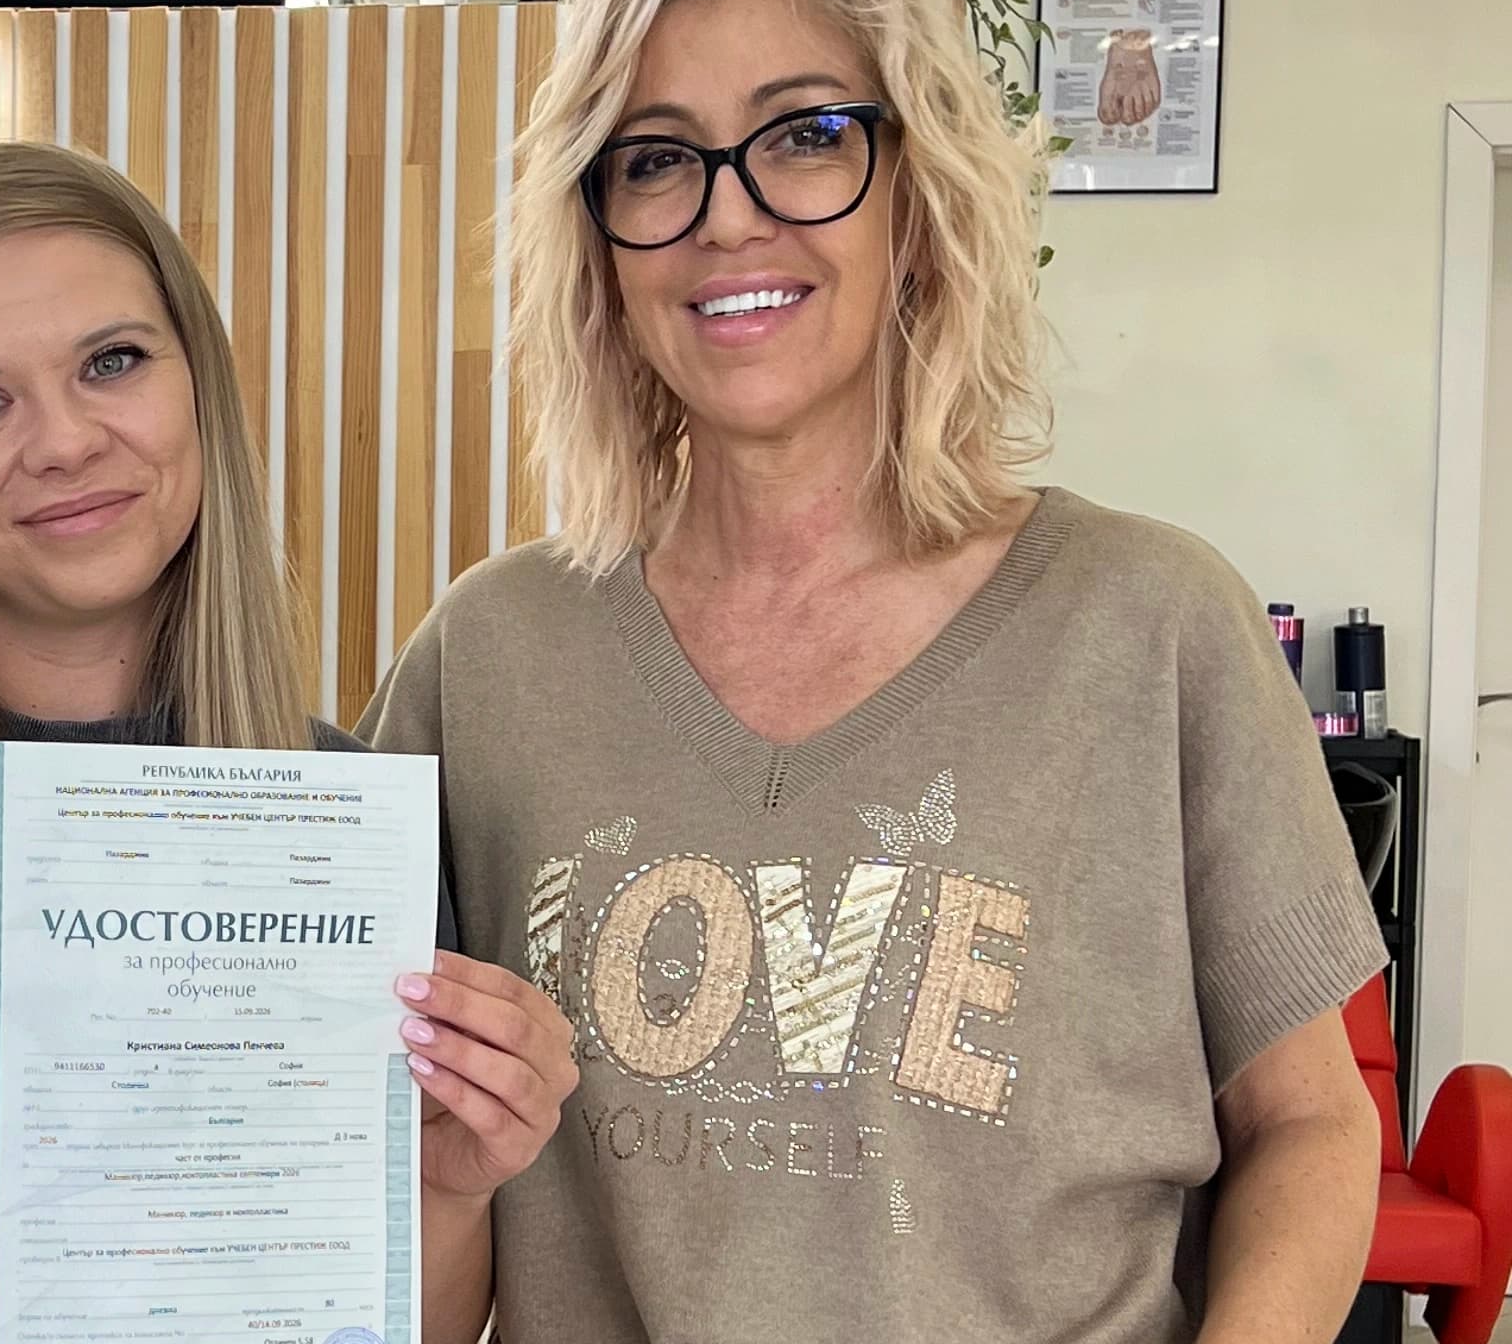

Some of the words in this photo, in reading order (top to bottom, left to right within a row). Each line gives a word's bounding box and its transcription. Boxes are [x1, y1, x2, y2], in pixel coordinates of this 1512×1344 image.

[142, 764, 225, 780] РЕПУБЛИКА
[229, 767, 302, 783] БЪЛГАРИЯ
[55, 786, 117, 796] НАЦИОНАЛНА
[119, 788, 158, 798] АГЕНЦИЯ
[320, 794, 363, 803] ОБУЧЕНИЕ
[41, 908, 376, 948] УДОСТОВЕРЕНИЕ
[123, 954, 143, 969] за
[150, 951, 297, 976] професионално
[167, 979, 256, 1003] обучение
[127, 1041, 181, 1053] Кристиана
[184, 1041, 240, 1051] Симеонова
[243, 1041, 285, 1050] Пенчева
[580, 1103, 887, 1180] YOURSELF
